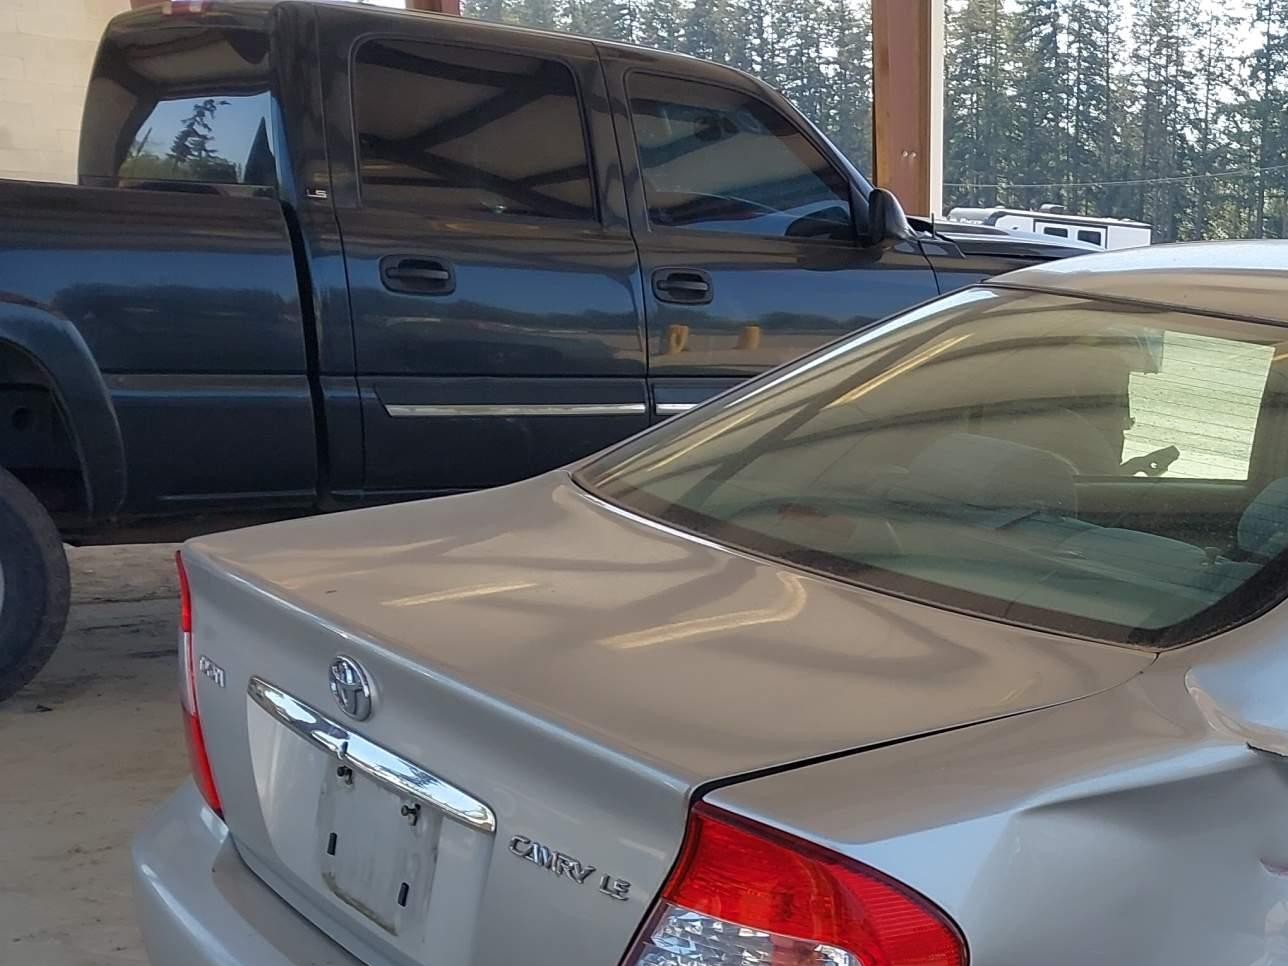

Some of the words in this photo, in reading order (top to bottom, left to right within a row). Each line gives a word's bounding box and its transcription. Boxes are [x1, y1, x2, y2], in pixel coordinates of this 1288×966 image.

[306, 188, 328, 199] LS
[508, 835, 597, 885] CAMRY
[599, 874, 631, 902] LE
